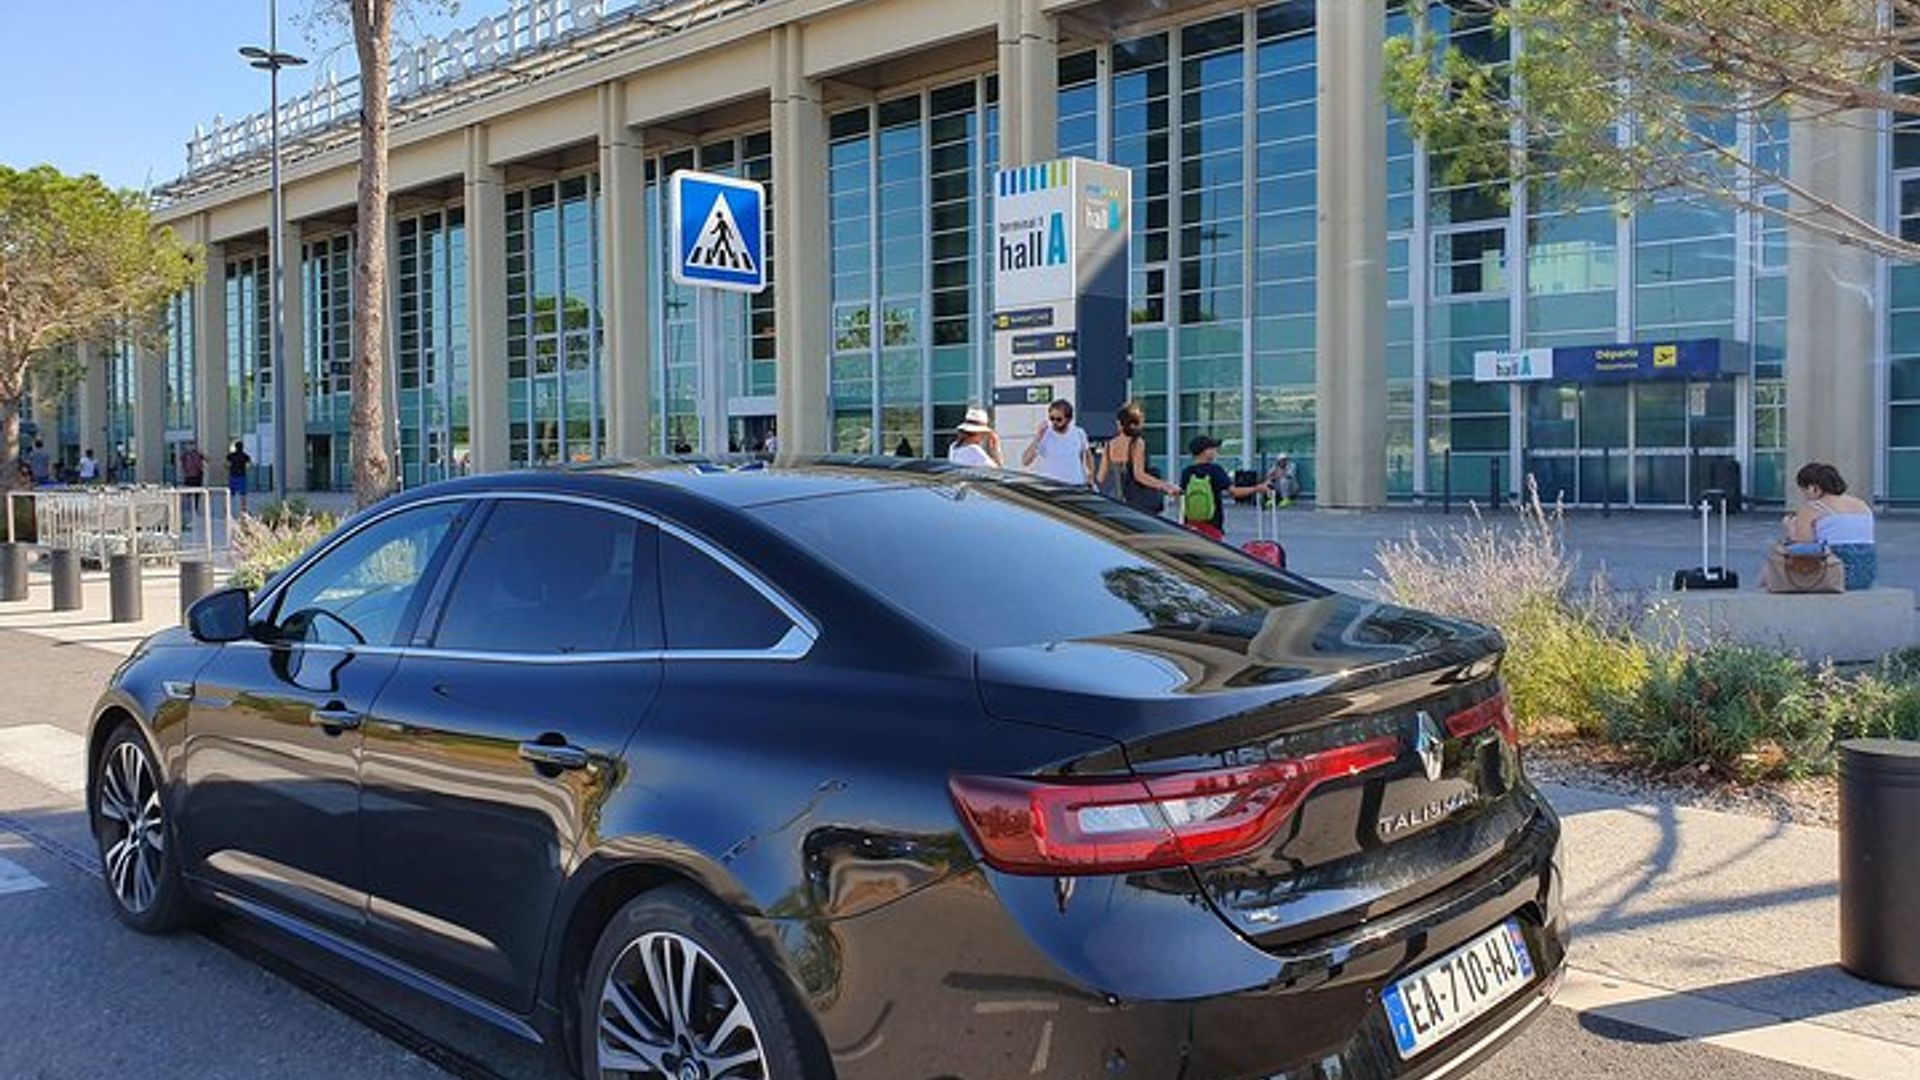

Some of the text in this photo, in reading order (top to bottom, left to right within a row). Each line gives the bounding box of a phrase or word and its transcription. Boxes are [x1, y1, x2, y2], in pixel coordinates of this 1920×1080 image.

[1000, 212, 1067, 271] hall A
[1380, 785, 1478, 834] TALISMAN
[1403, 930, 1518, 1034] EA-710-HJ
